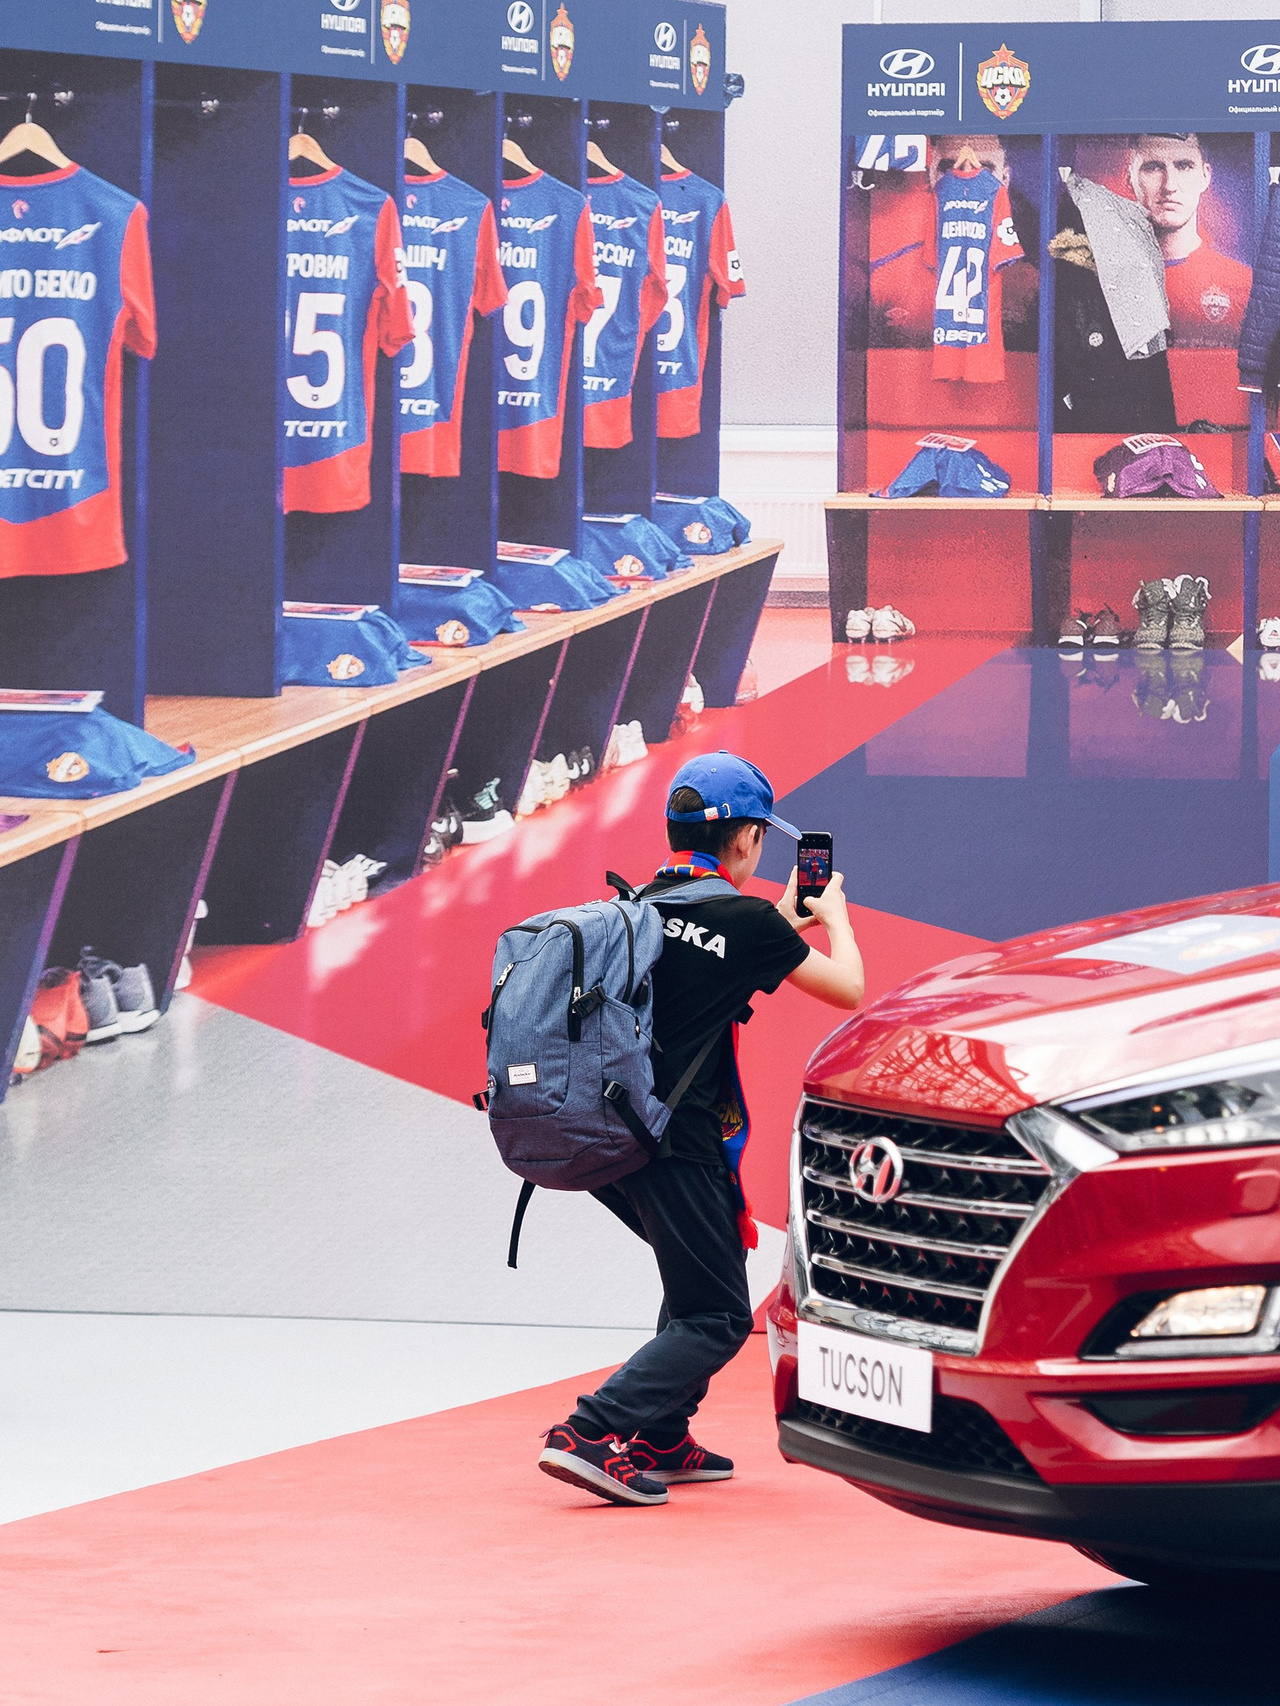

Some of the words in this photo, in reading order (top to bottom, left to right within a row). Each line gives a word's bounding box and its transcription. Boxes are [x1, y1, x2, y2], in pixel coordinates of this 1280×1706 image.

[867, 82, 946, 97] HYUNDAI
[981, 66, 1027, 88] ЦСКА
[936, 246, 985, 325] 42
[502, 280, 546, 381] 9
[661, 916, 726, 959] SKA
[819, 1345, 903, 1407] TUCSON
